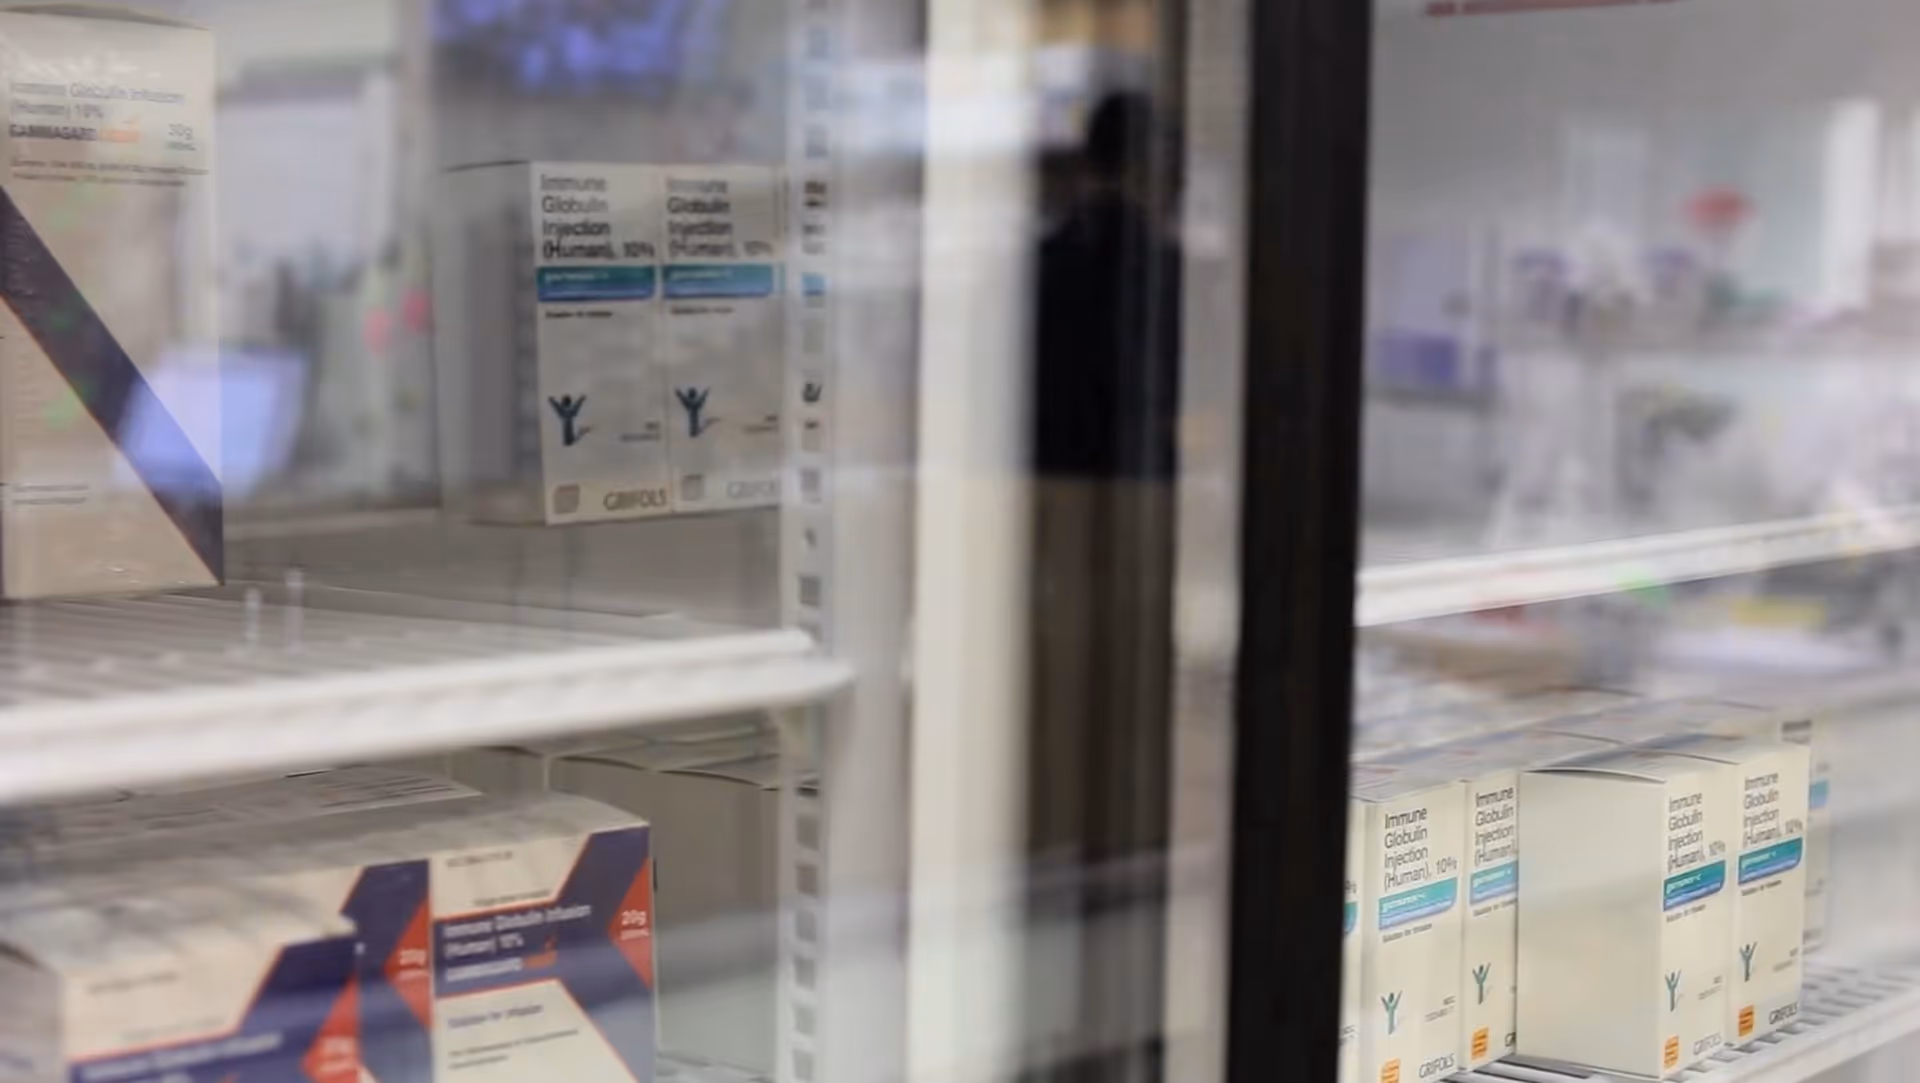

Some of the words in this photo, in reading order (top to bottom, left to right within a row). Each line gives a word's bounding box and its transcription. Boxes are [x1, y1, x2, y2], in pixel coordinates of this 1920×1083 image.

[541, 174, 607, 191] Immune
[542, 197, 608, 213] Globulin
[667, 197, 730, 213] Globulin
[543, 220, 611, 240] Injection
[668, 221, 733, 240] Injection
[1745, 773, 1778, 791] Immune
[1475, 787, 1514, 807] Immune
[1669, 792, 1702, 812] Immune
[1744, 789, 1779, 810] Globulin
[1385, 808, 1427, 829] Immune
[1475, 804, 1514, 826] Globulin
[1669, 809, 1702, 831] Globulin
[1384, 826, 1427, 848] Globulin
[1475, 825, 1514, 850] Injection
[1384, 846, 1428, 871] Injection
[1436, 857, 1457, 875] 10%
[1419, 1053, 1455, 1079] GRIFOLS
